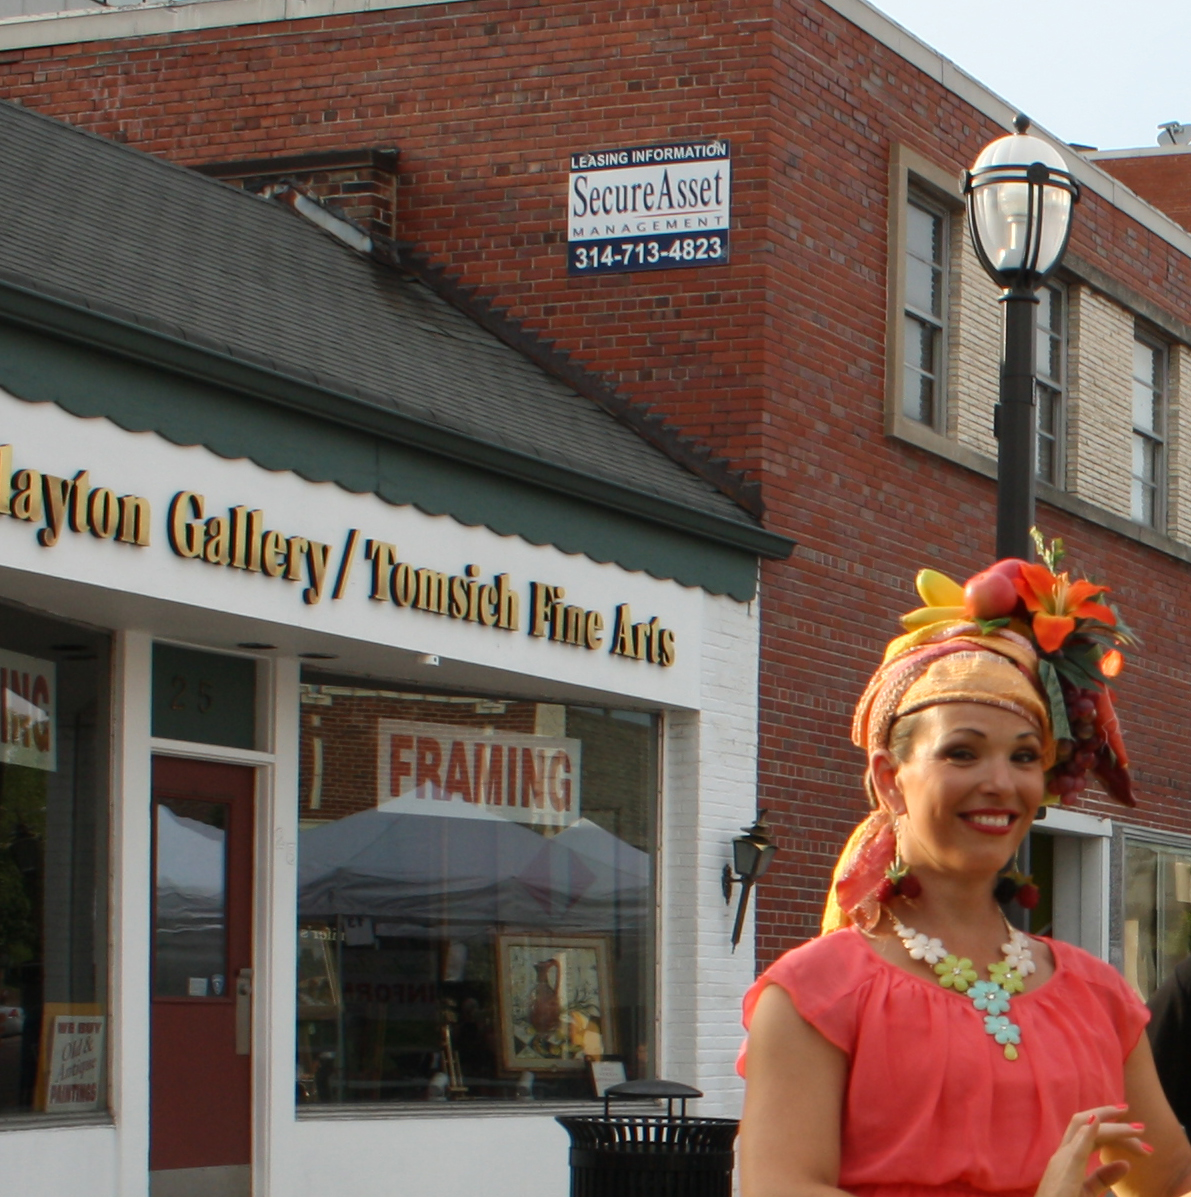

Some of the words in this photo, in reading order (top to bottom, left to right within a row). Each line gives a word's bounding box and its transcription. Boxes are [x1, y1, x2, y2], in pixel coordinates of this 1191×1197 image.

[571, 153, 628, 169] LEASING
[632, 142, 726, 163] INFORMATION
[572, 215, 723, 237] MANAGEMENT
[575, 236, 722, 269] 314-713-4823
[529, 580, 605, 650] Fine
[609, 602, 676, 667] Arts
[0, 666, 50, 752] ING
[169, 674, 214, 713] 25
[389, 733, 572, 812] FRAMING
